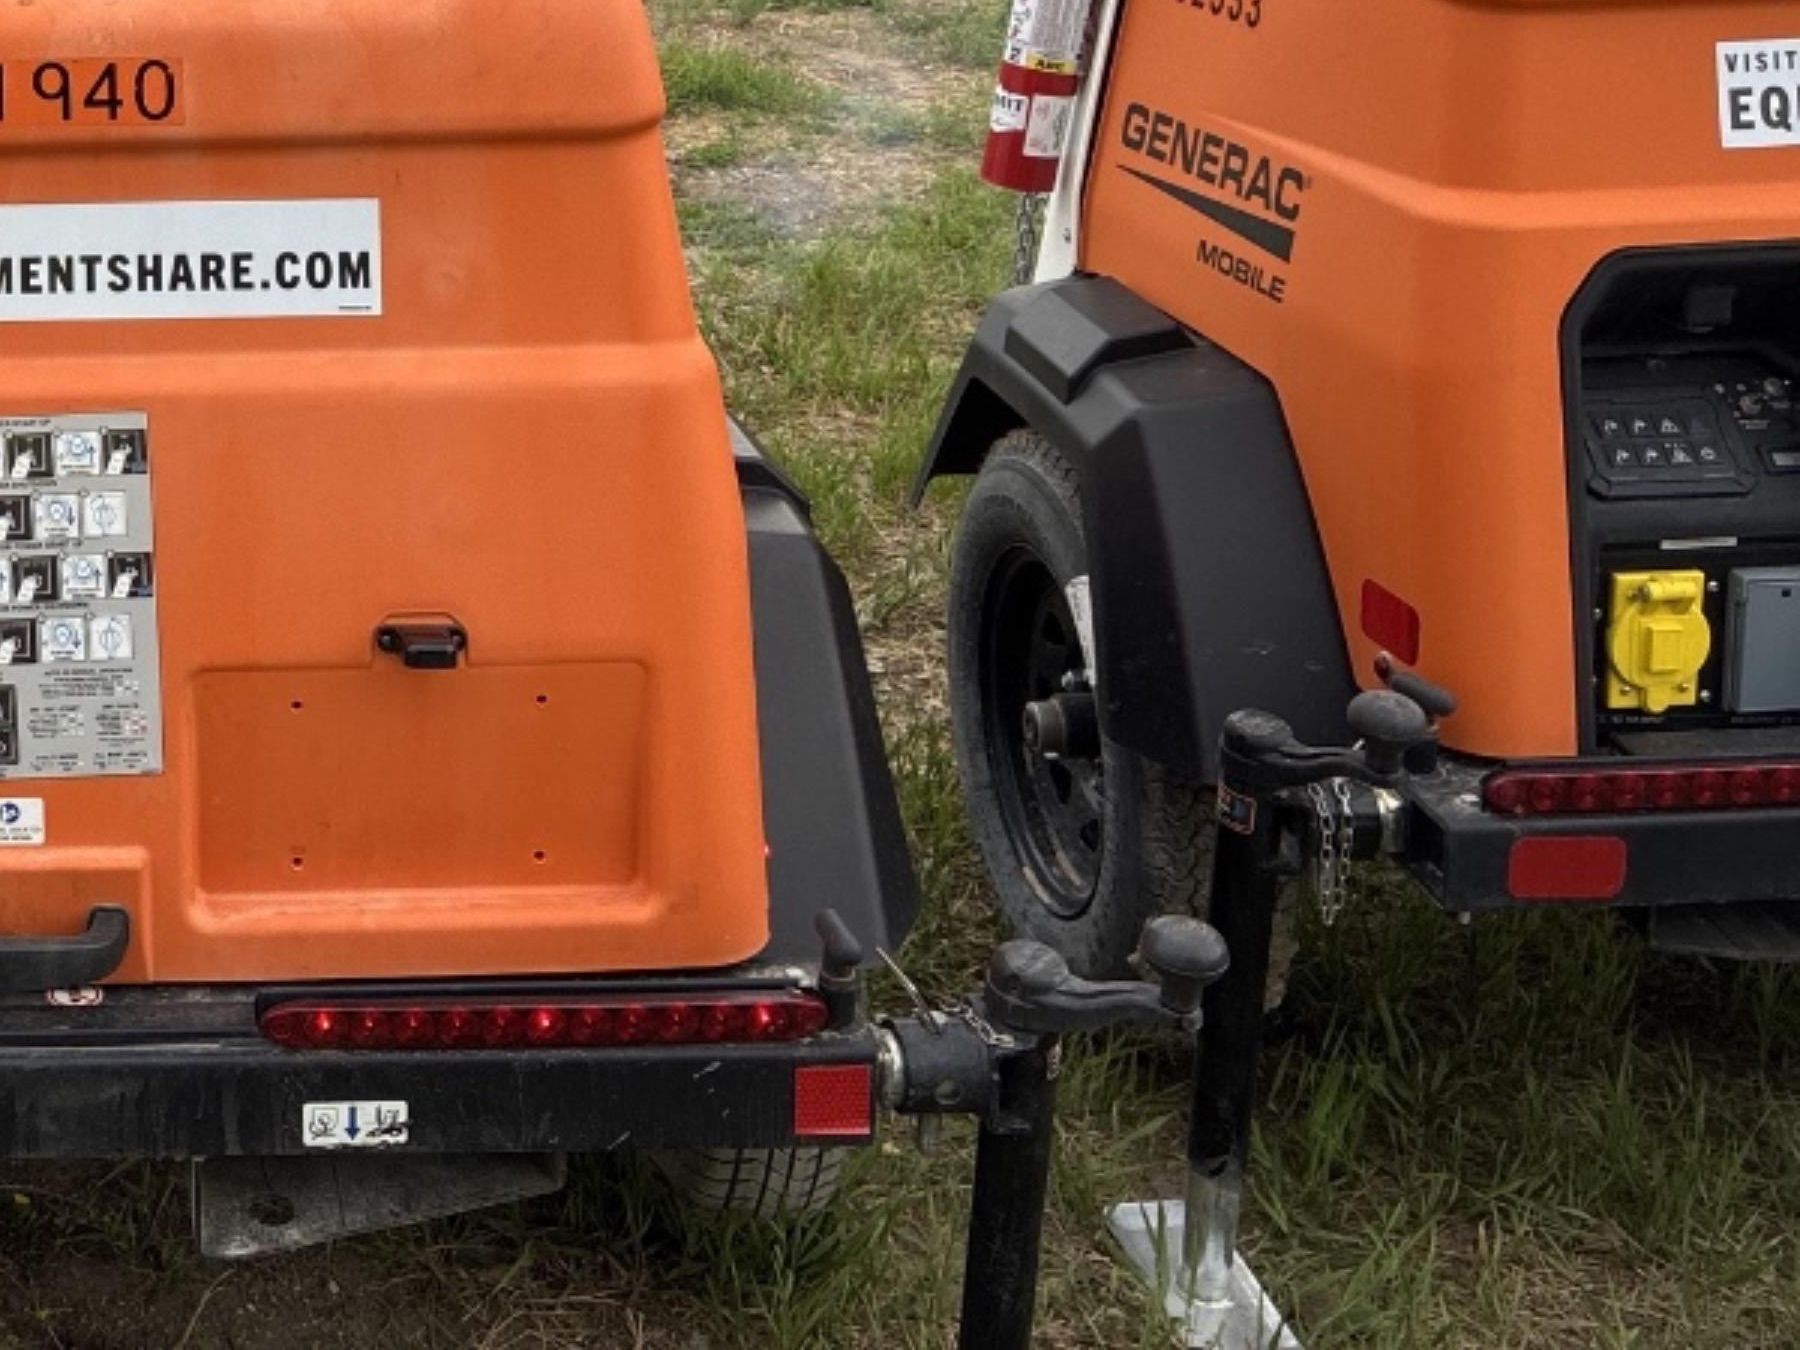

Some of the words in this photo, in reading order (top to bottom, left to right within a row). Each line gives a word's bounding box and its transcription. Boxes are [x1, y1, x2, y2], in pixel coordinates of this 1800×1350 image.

[1724, 50, 1798, 73] VISIT
[1728, 85, 1800, 133] EQ
[1121, 102, 1304, 222] GENERAC
[1196, 238, 1288, 304] MOBILE
